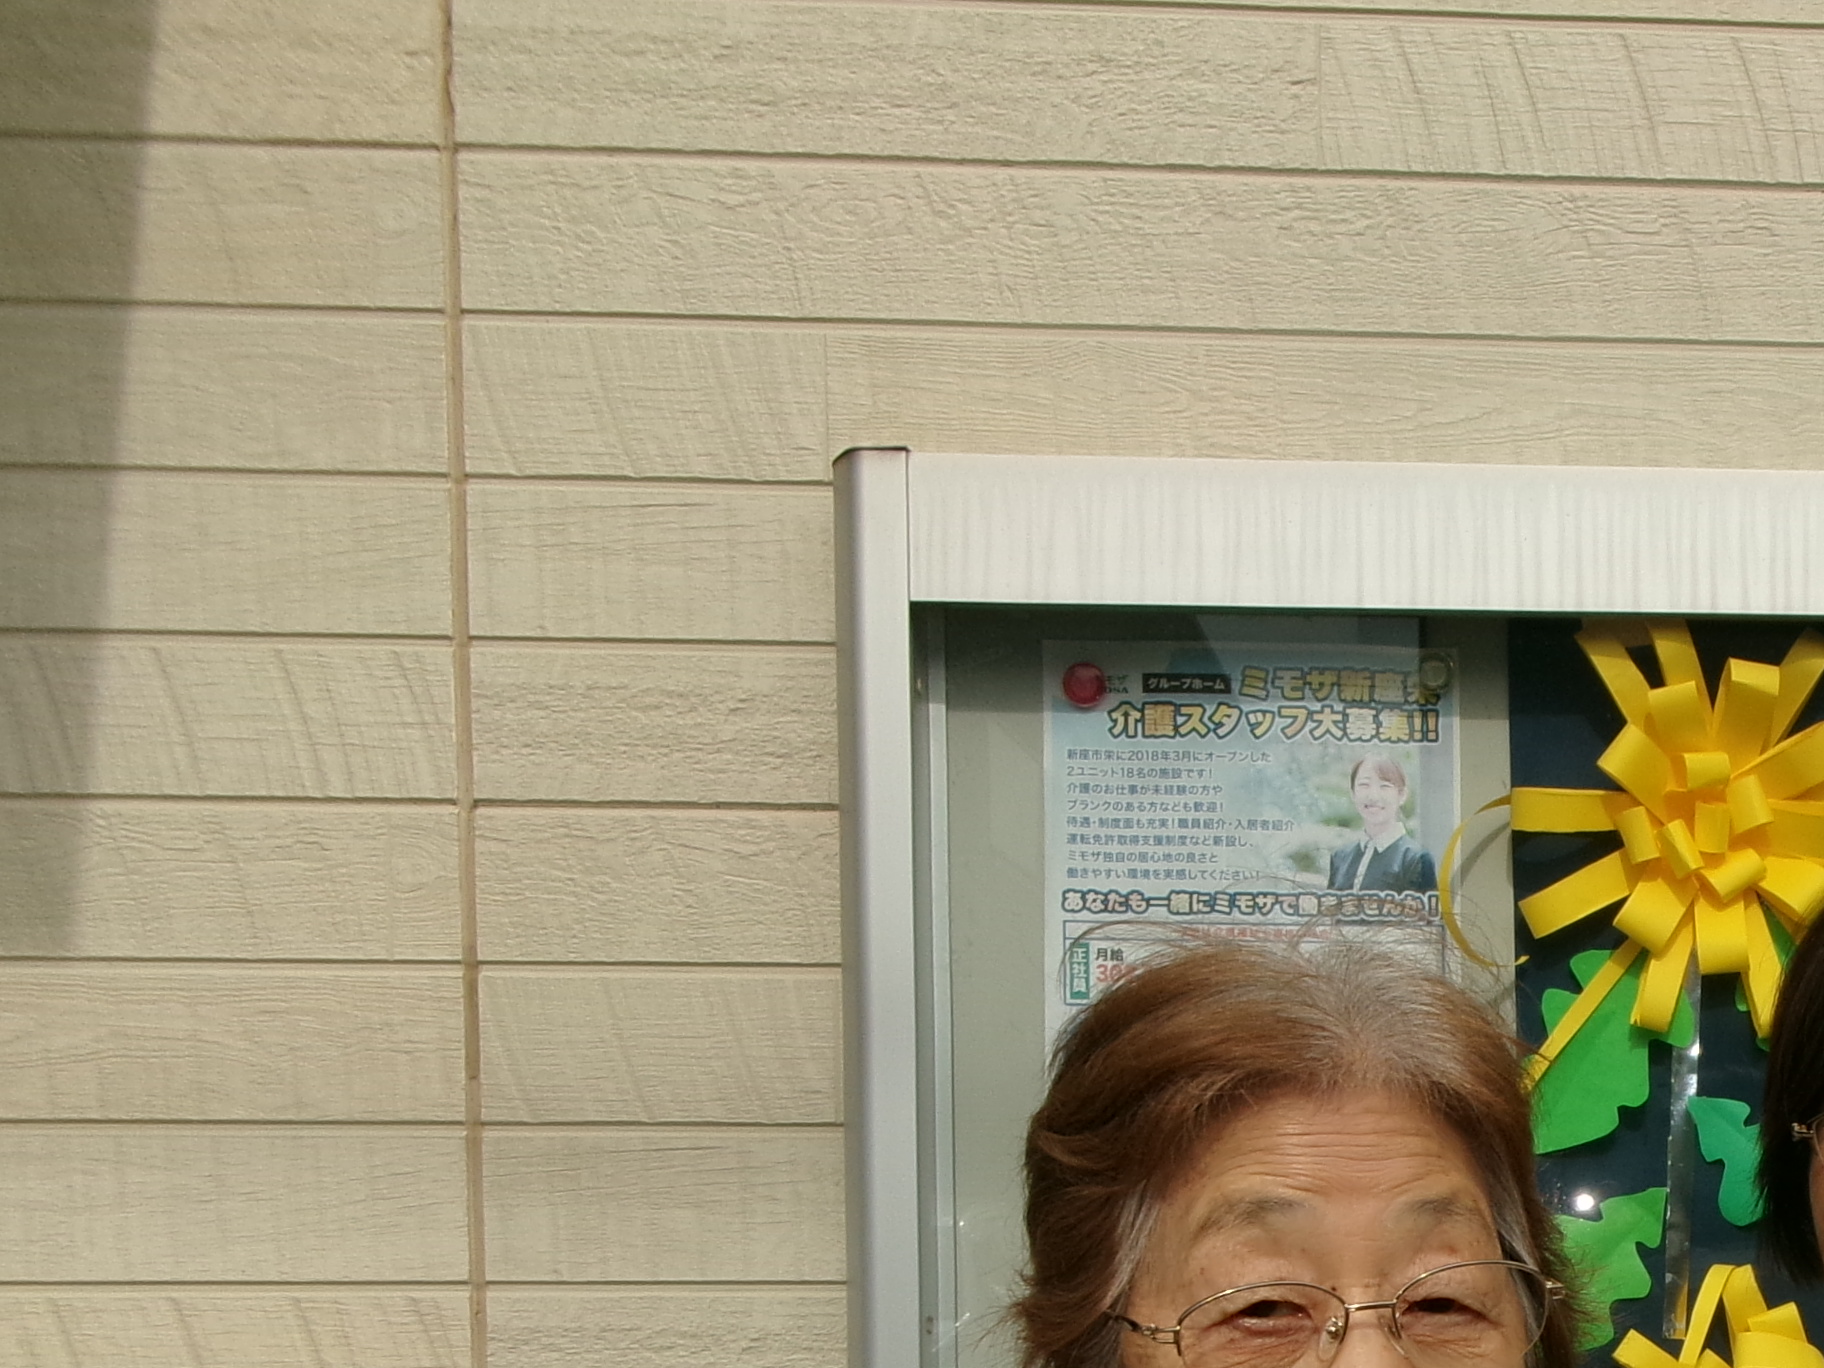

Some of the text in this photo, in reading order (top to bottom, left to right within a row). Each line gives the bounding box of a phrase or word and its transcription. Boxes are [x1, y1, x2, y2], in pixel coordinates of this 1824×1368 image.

[1147, 677, 1226, 690] グループホーム
[1107, 701, 1440, 743] 介護スタッフ大募集!!
[1066, 782, 1223, 796] 介護のお仕事が未経験の方や
[1067, 850, 1219, 864] ミモザ独自の居心地の良さと
